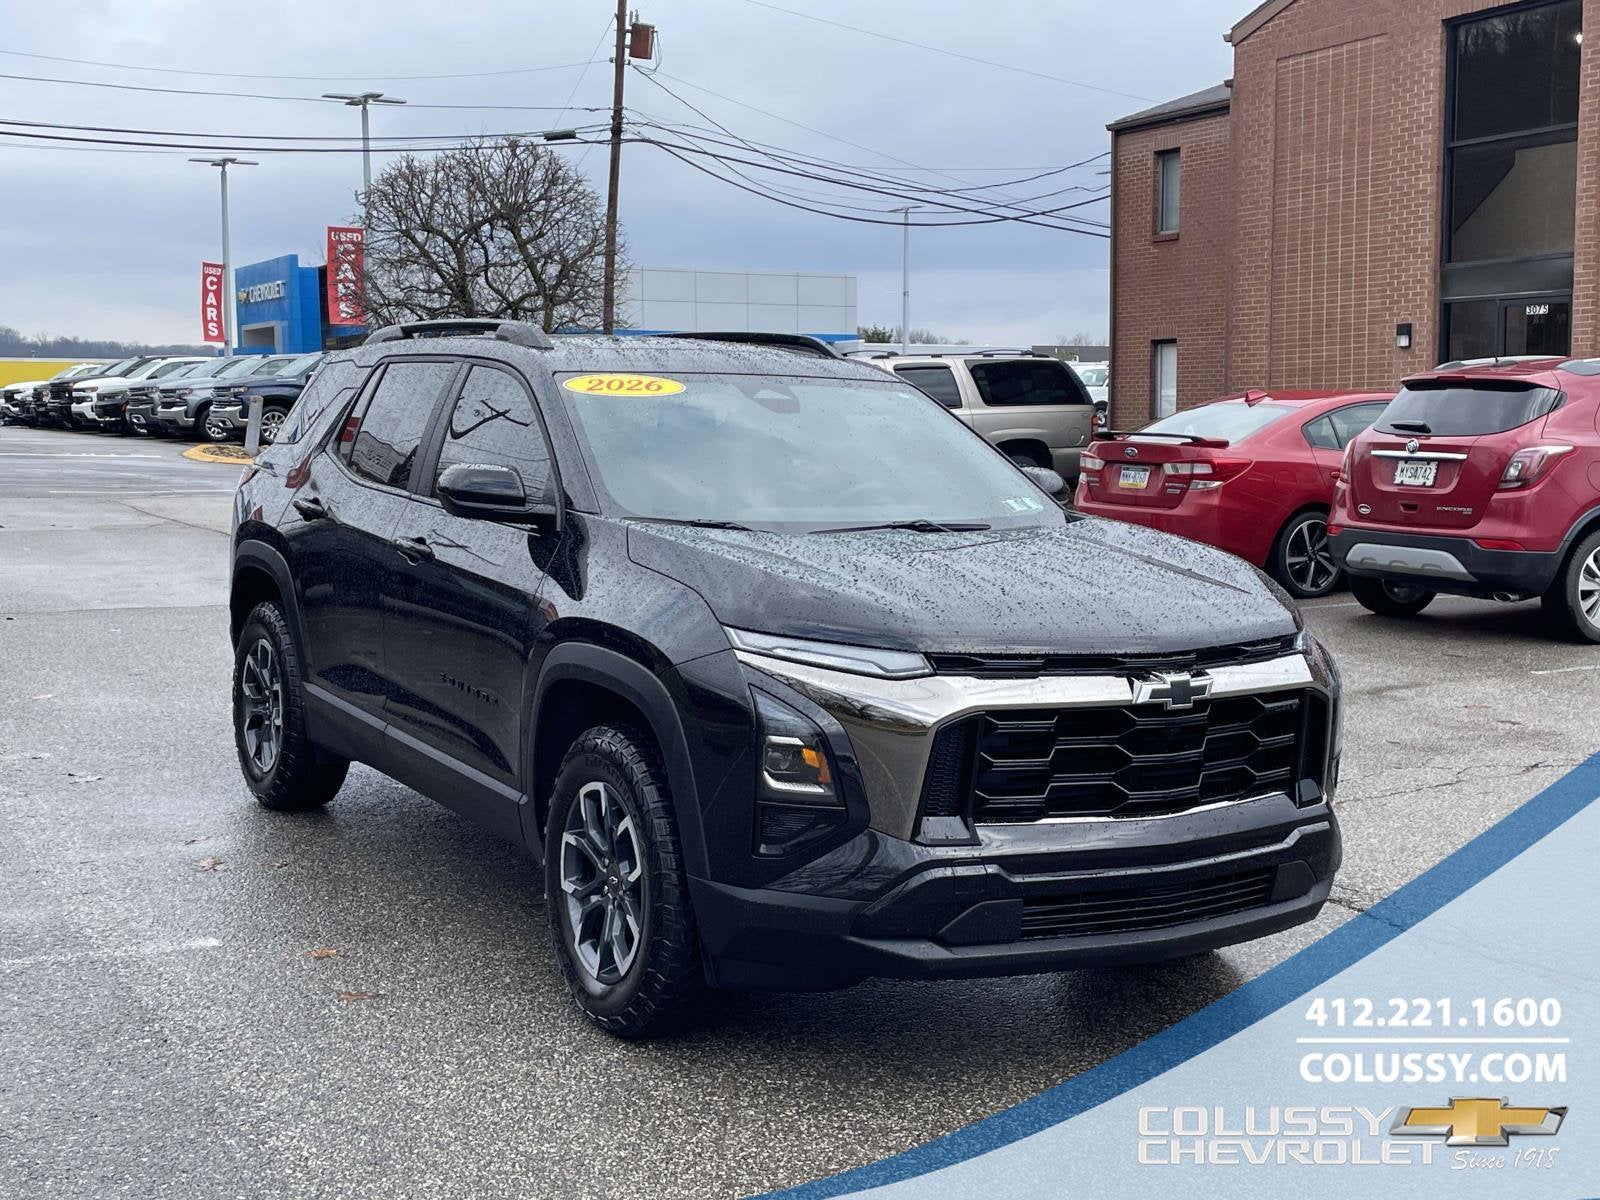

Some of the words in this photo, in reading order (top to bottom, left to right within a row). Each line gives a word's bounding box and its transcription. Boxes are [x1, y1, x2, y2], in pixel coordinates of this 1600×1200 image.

[331, 231, 362, 242] USED
[204, 267, 222, 275] USED
[336, 243, 356, 318] CARS
[249, 280, 286, 303] CHEVROLET
[206, 276, 219, 337] CARS
[1527, 304, 1548, 314] 3075
[586, 378, 663, 392] 2026
